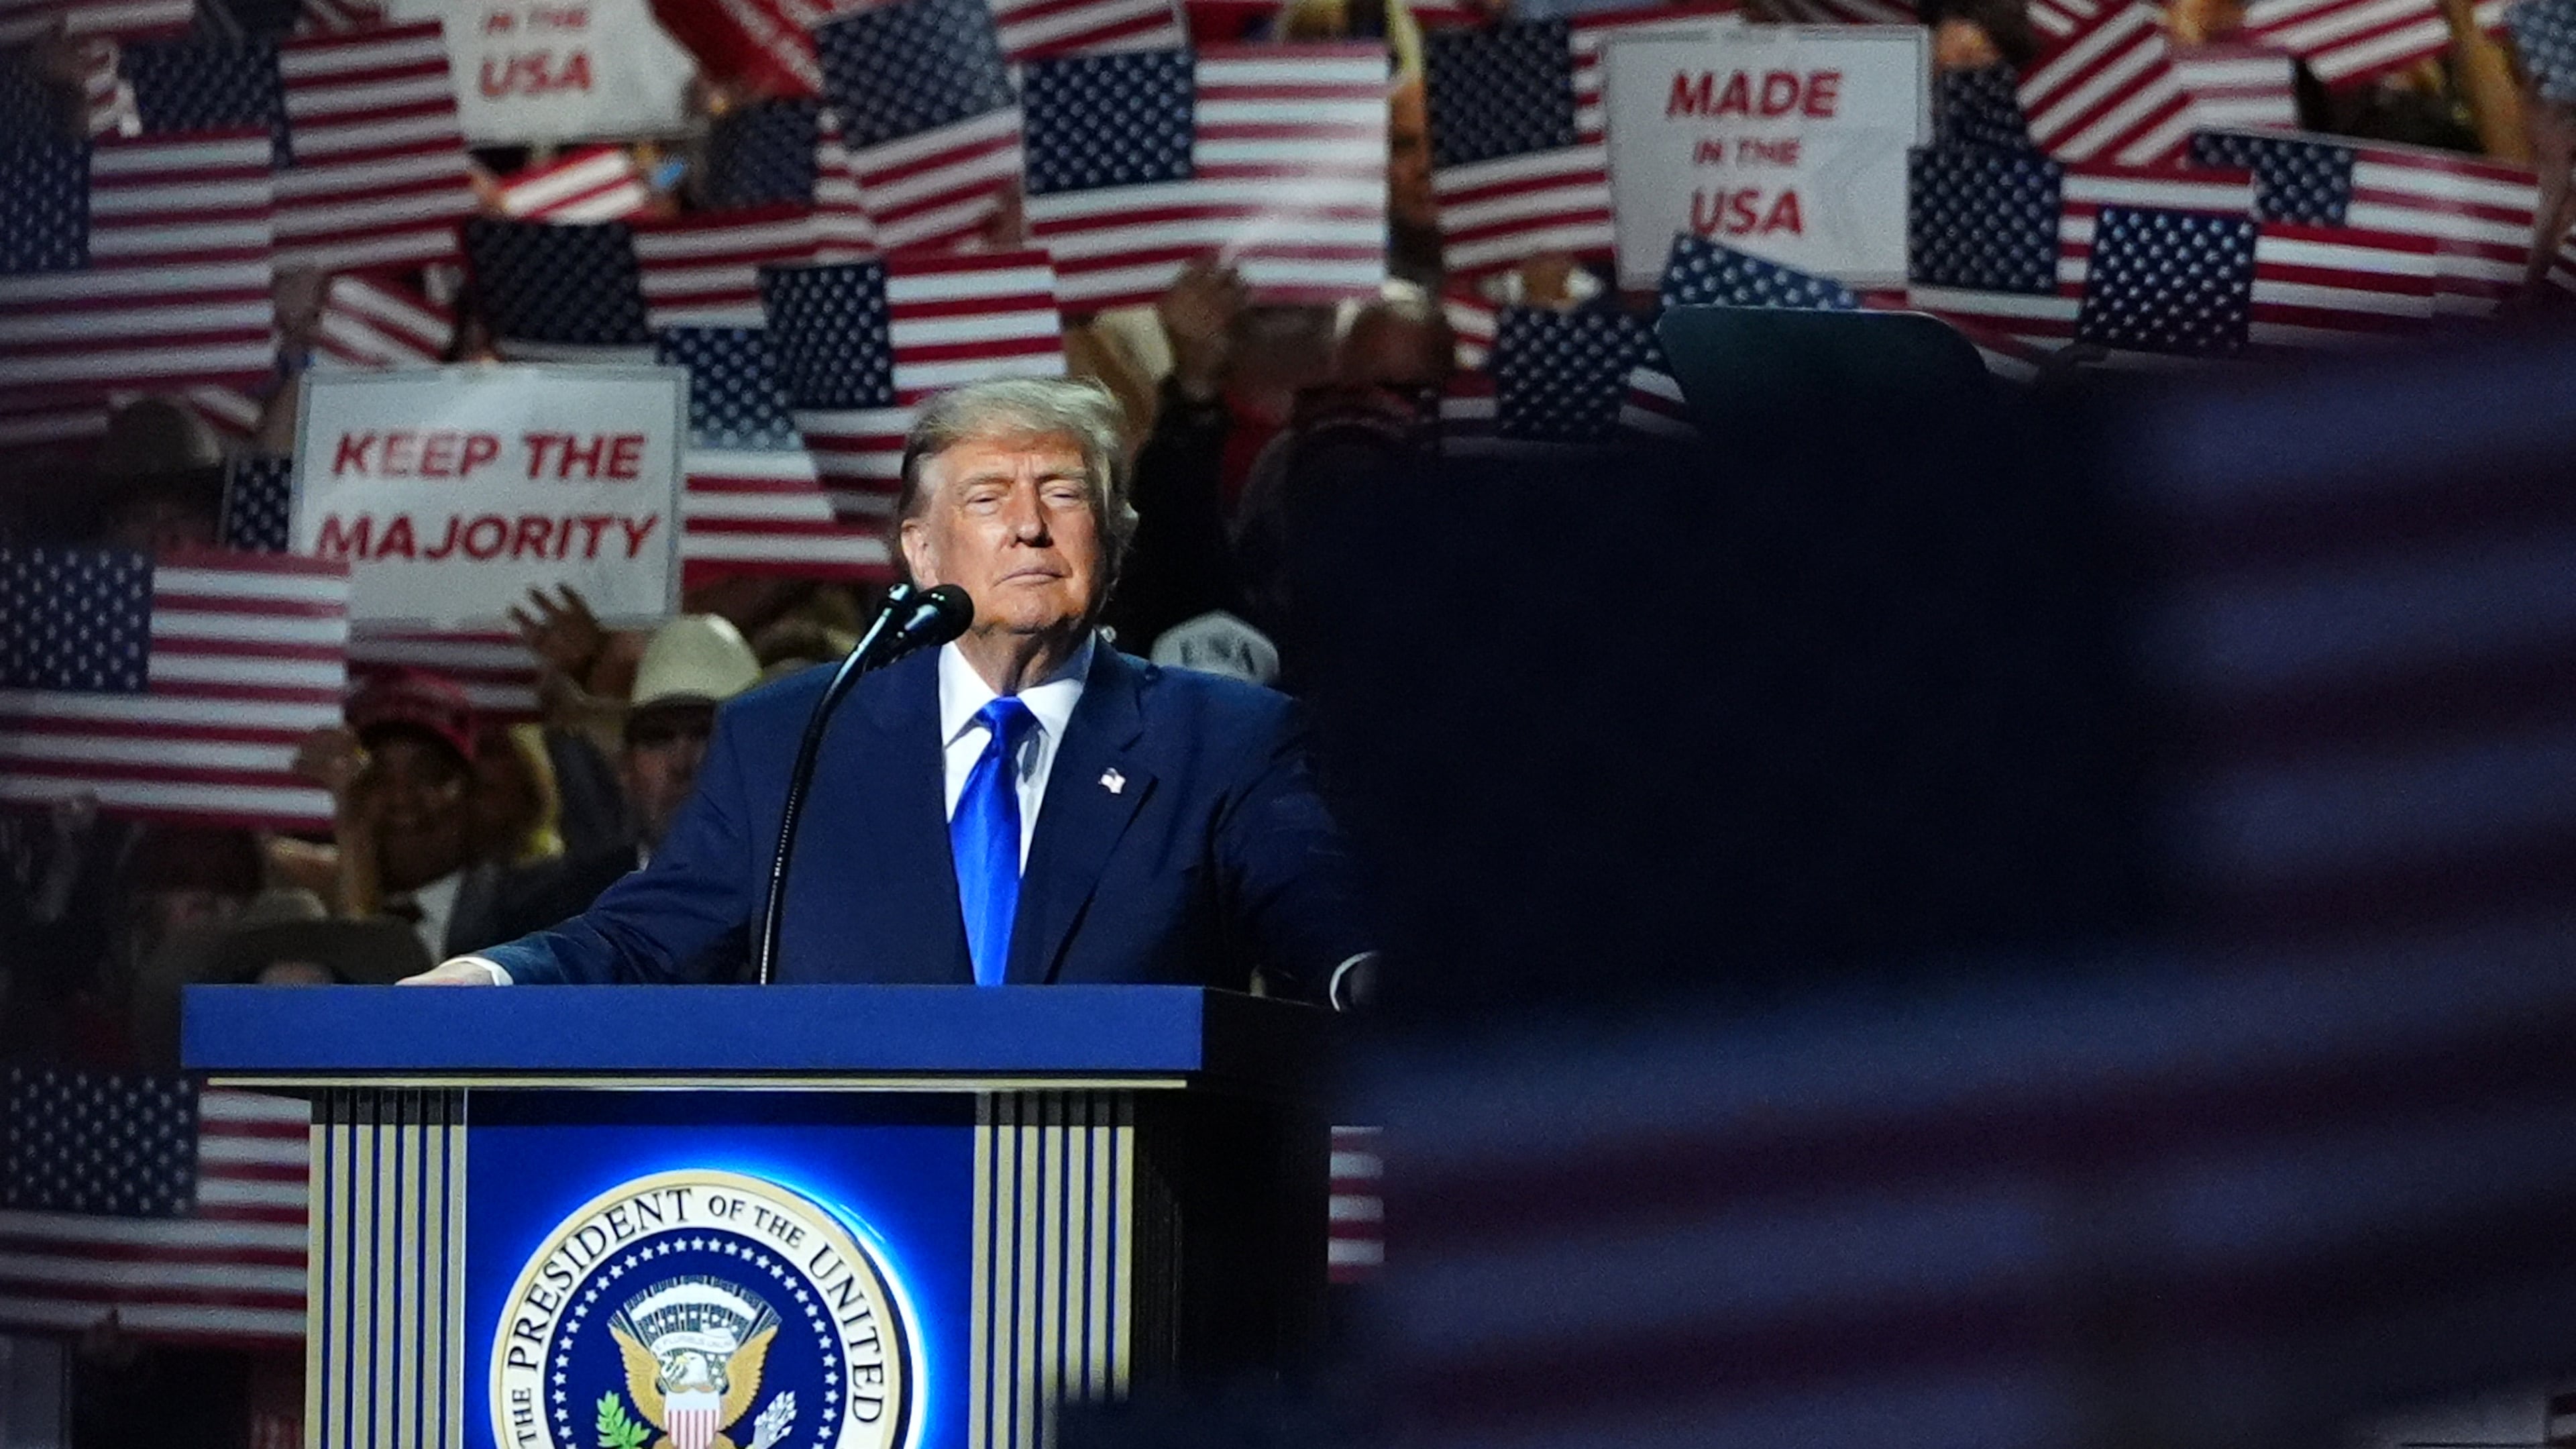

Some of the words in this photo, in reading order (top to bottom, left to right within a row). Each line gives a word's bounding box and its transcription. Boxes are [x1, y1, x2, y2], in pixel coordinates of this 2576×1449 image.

[479, 52, 592, 98] USA
[1665, 69, 1843, 119] MADE
[1693, 139, 1723, 165] IN
[1736, 136, 1804, 167] THE
[1688, 186, 1805, 239] USA
[331, 429, 502, 476] KEEP
[521, 429, 647, 480] THE
[315, 514, 659, 561] MAJORITY
[708, 1195, 746, 1221] OF
[754, 1205, 806, 1249] THE
[508, 1188, 692, 1373] PRESIDENT
[808, 1242, 885, 1423] UNITED
[512, 1387, 538, 1449] THE
